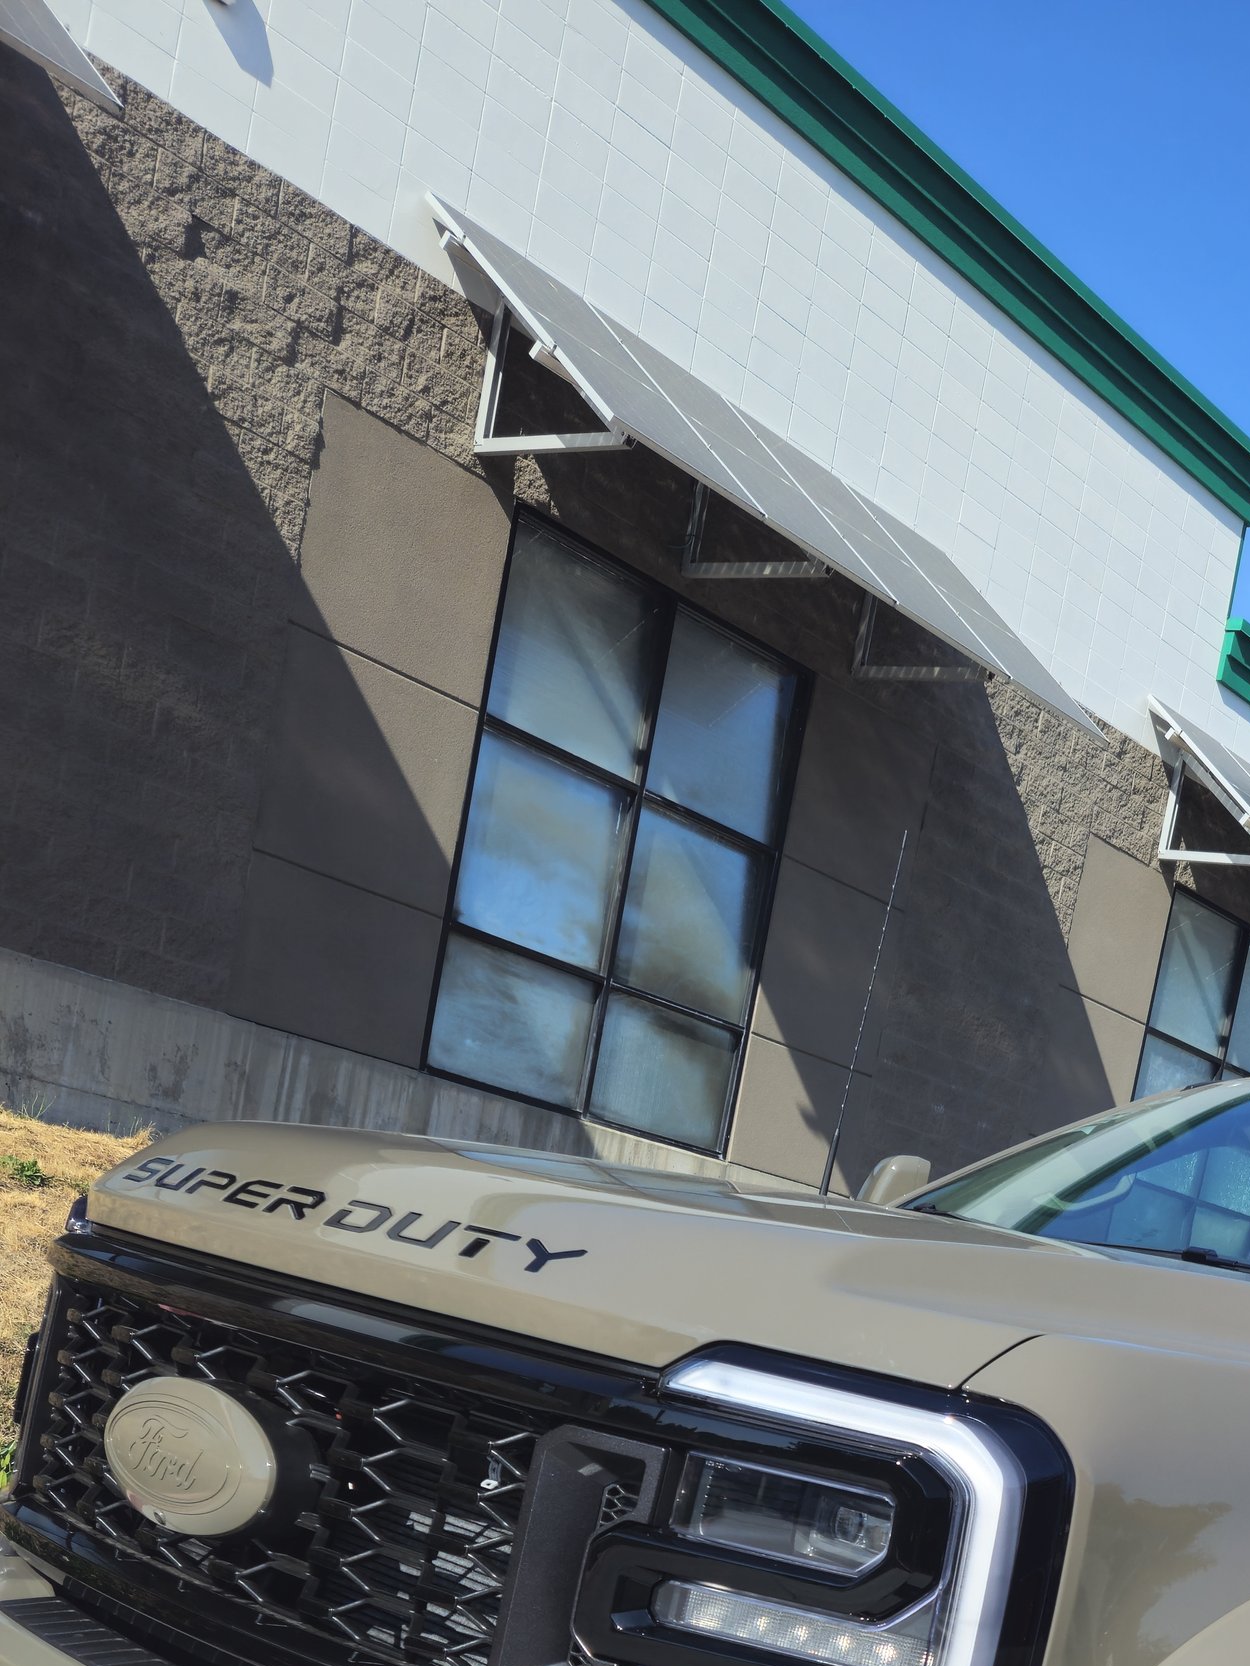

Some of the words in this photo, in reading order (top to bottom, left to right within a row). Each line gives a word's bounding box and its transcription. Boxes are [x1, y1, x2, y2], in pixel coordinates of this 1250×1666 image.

[122, 1156, 327, 1221] SUPER
[322, 1200, 588, 1273] DUTY
[129, 1413, 204, 1491] Ford
